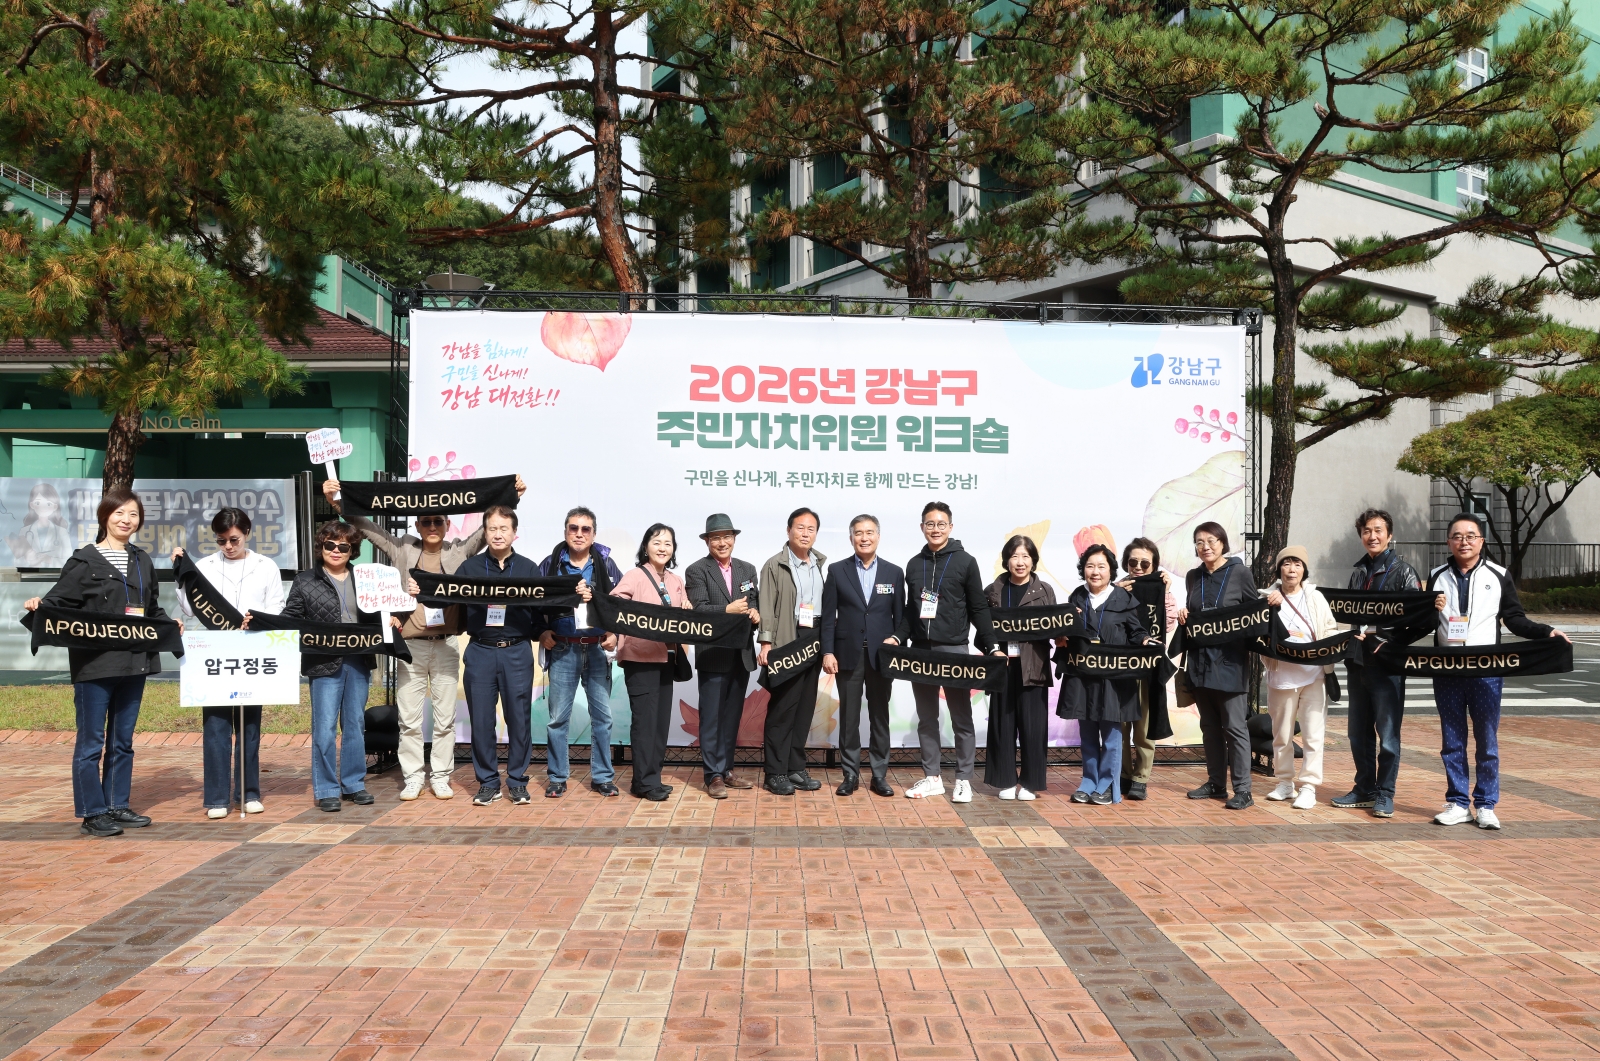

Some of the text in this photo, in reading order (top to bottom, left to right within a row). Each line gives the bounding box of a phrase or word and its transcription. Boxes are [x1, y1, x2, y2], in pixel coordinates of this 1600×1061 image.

[441, 338, 529, 360] 강남을 힘차게!
[441, 364, 529, 384] 구민을 신나게!
[1168, 356, 1222, 376] 강남구
[689, 364, 978, 406] 2026년 강남구
[441, 386, 561, 411] 강남 대전환!!
[656, 411, 1009, 454] 주민자치위원 워크숍
[684, 469, 978, 490] 구민을 신나게, 주민자치로 함께 만드는 강남!
[371, 491, 477, 509] APGUJEONG
[359, 593, 378, 608] 강남
[434, 583, 545, 598] APGUJEONG
[1329, 600, 1404, 616] APGUJEONG
[45, 618, 158, 640] APGUJEONG
[615, 611, 713, 637] APGUJEONG
[992, 612, 1074, 632] PGUJEONG
[300, 633, 382, 648] GUJEONG
[204, 658, 278, 676] 압구정동
[768, 640, 820, 677] APGUJEO
[889, 657, 987, 680] APGUJEONG
[1404, 653, 1520, 669] APGUJEONG
